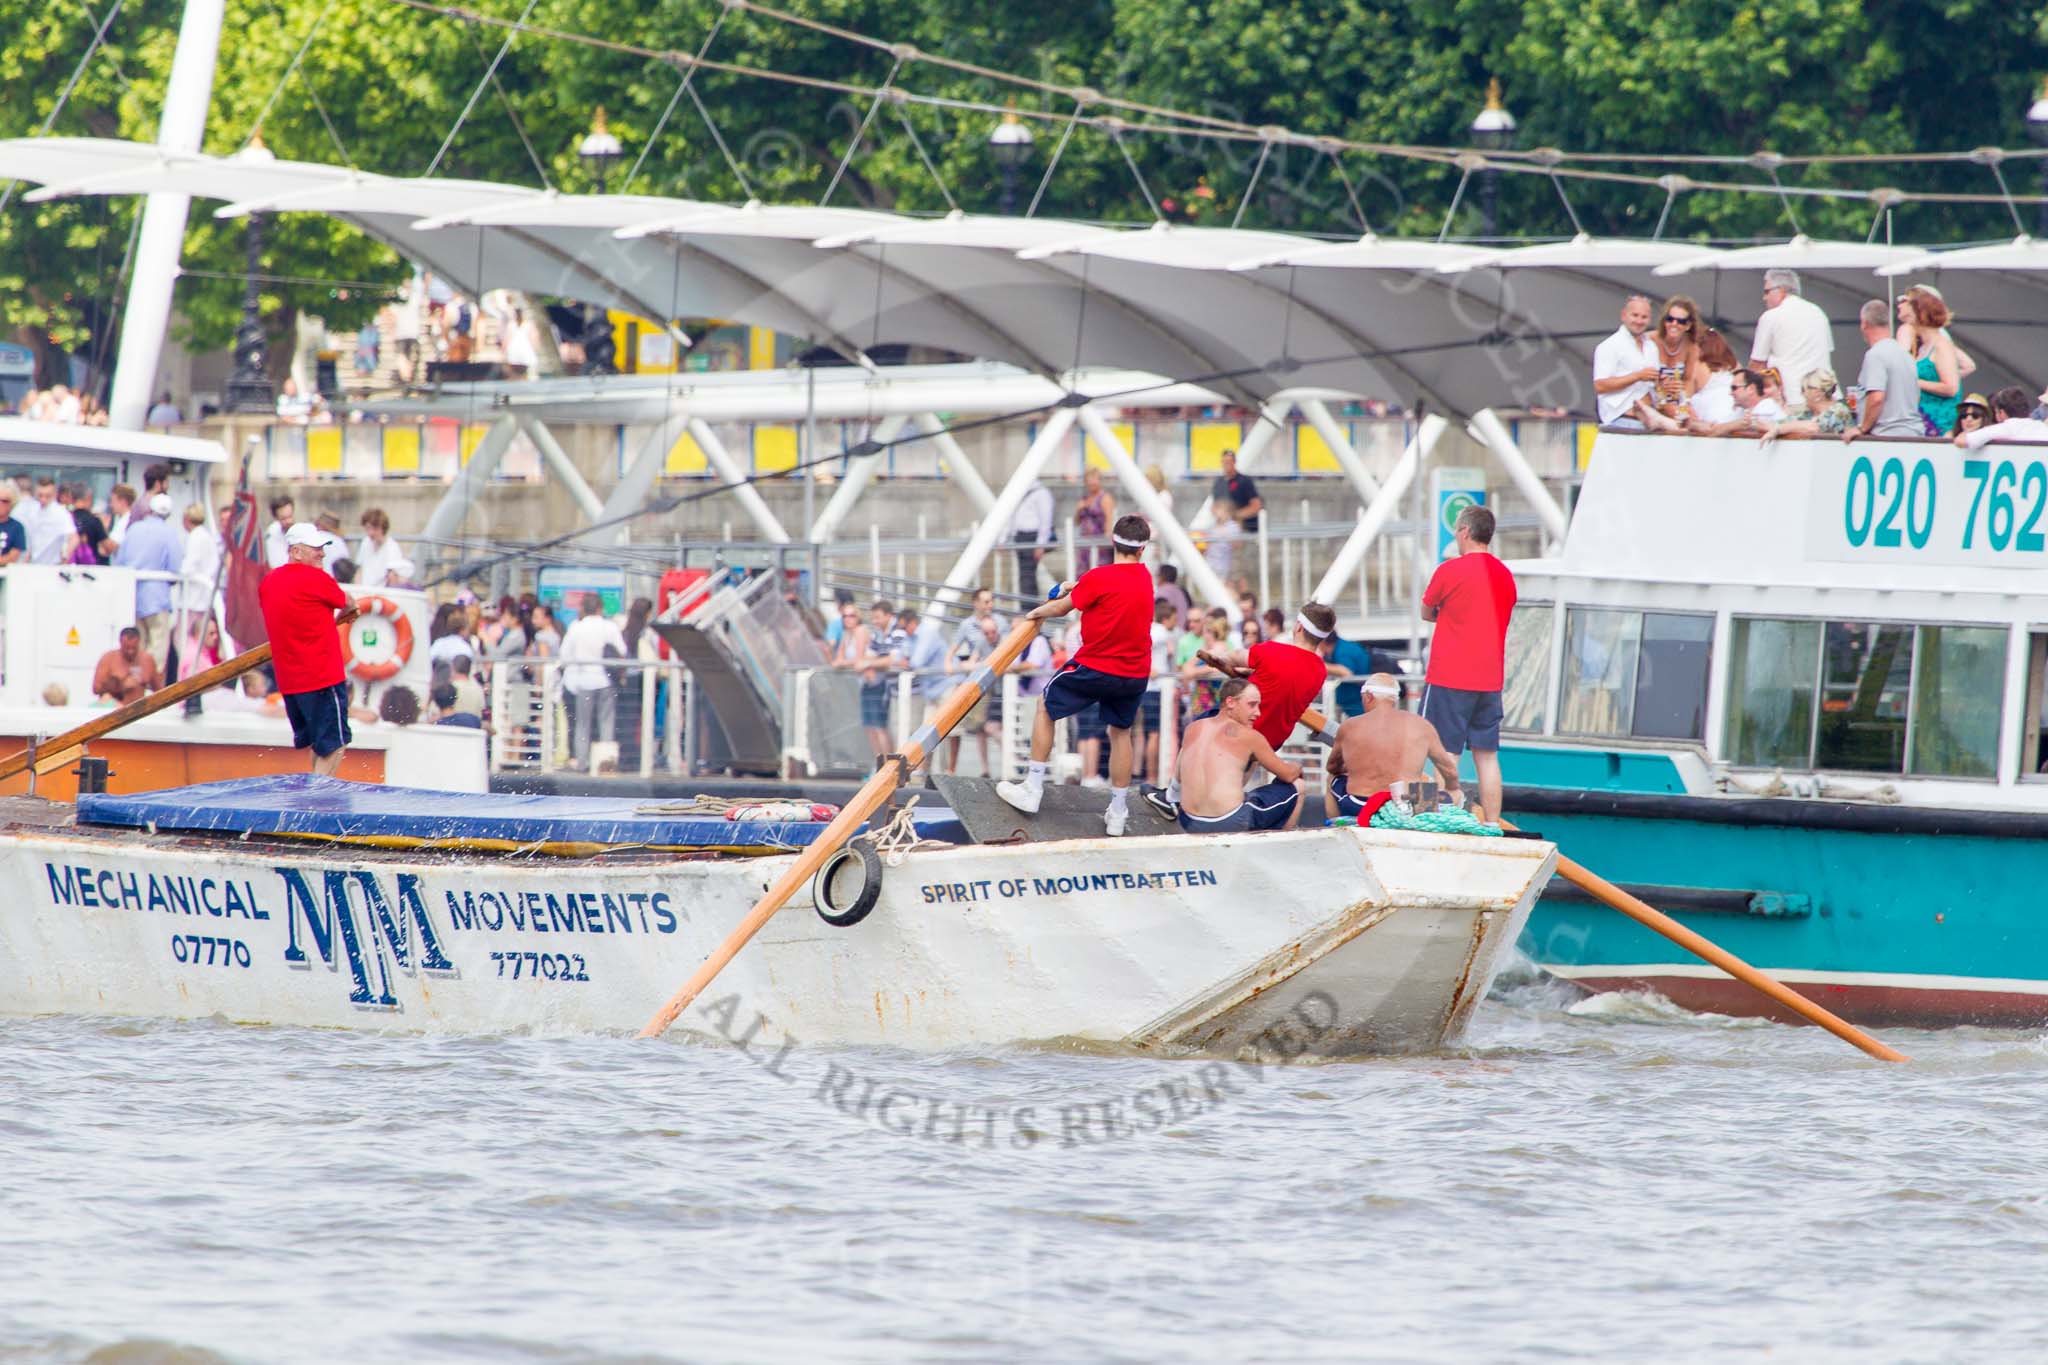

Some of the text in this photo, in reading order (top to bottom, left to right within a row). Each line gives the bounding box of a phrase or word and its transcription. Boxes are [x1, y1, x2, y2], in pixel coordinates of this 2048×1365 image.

[1845, 456, 2048, 553] 020 762
[46, 862, 271, 921] MECHANICAL
[445, 890, 678, 934] MOVEMENTS
[920, 869, 1219, 904] SPIRIT OF MOUNTBATTEN
[172, 935, 591, 983] 07770 777022
